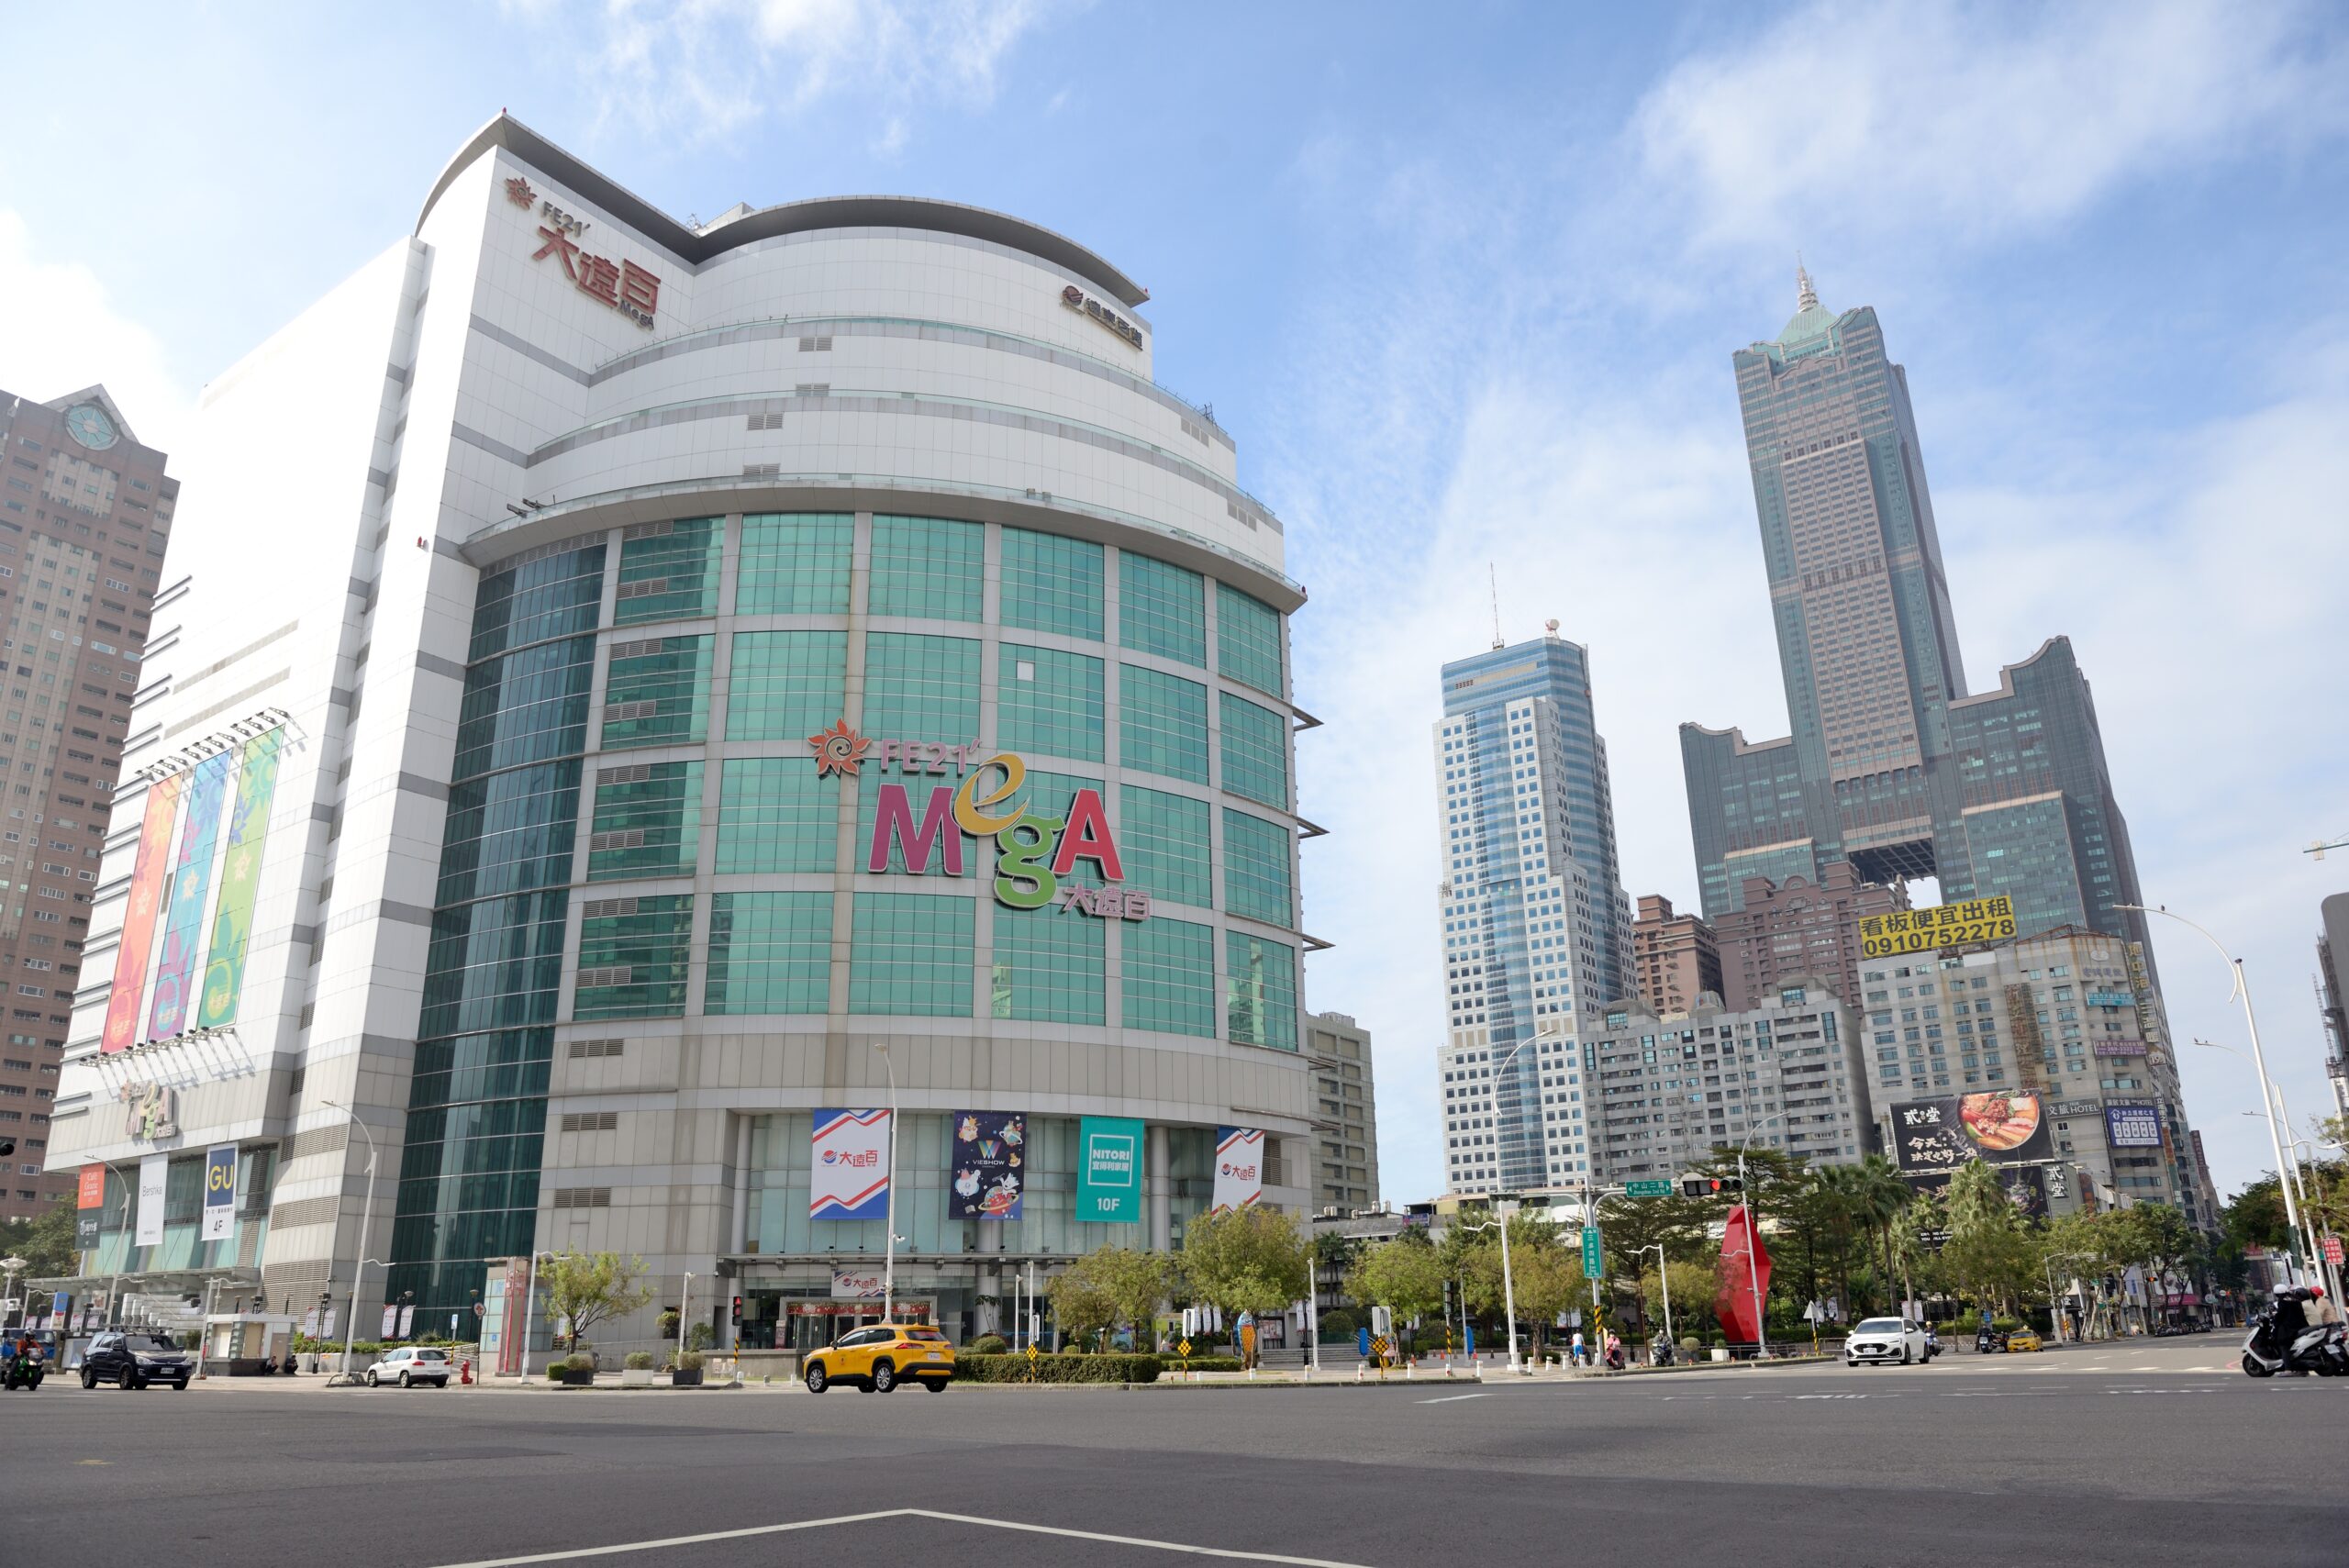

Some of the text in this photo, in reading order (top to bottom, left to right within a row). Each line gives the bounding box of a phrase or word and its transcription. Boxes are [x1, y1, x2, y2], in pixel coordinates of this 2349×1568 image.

[531, 225, 662, 315] 大遠百
[1063, 882, 1152, 921] 大遠百
[1861, 897, 2012, 937] 看板便宜出租
[1864, 919, 2015, 956] 0910752278
[2070, 1104, 2099, 1114] HOTEL
[839, 1150, 878, 1167] 大遠百
[1092, 1149, 1130, 1161] NITORI
[208, 1164, 234, 1191] GU
[1231, 1165, 1256, 1181] 大遠百
[141, 1184, 162, 1196] Bershka
[1632, 1181, 1665, 1189] 中山二路
[1097, 1197, 1120, 1211] 10F
[213, 1219, 223, 1233] 4F
[852, 1277, 878, 1289] 大遠百
